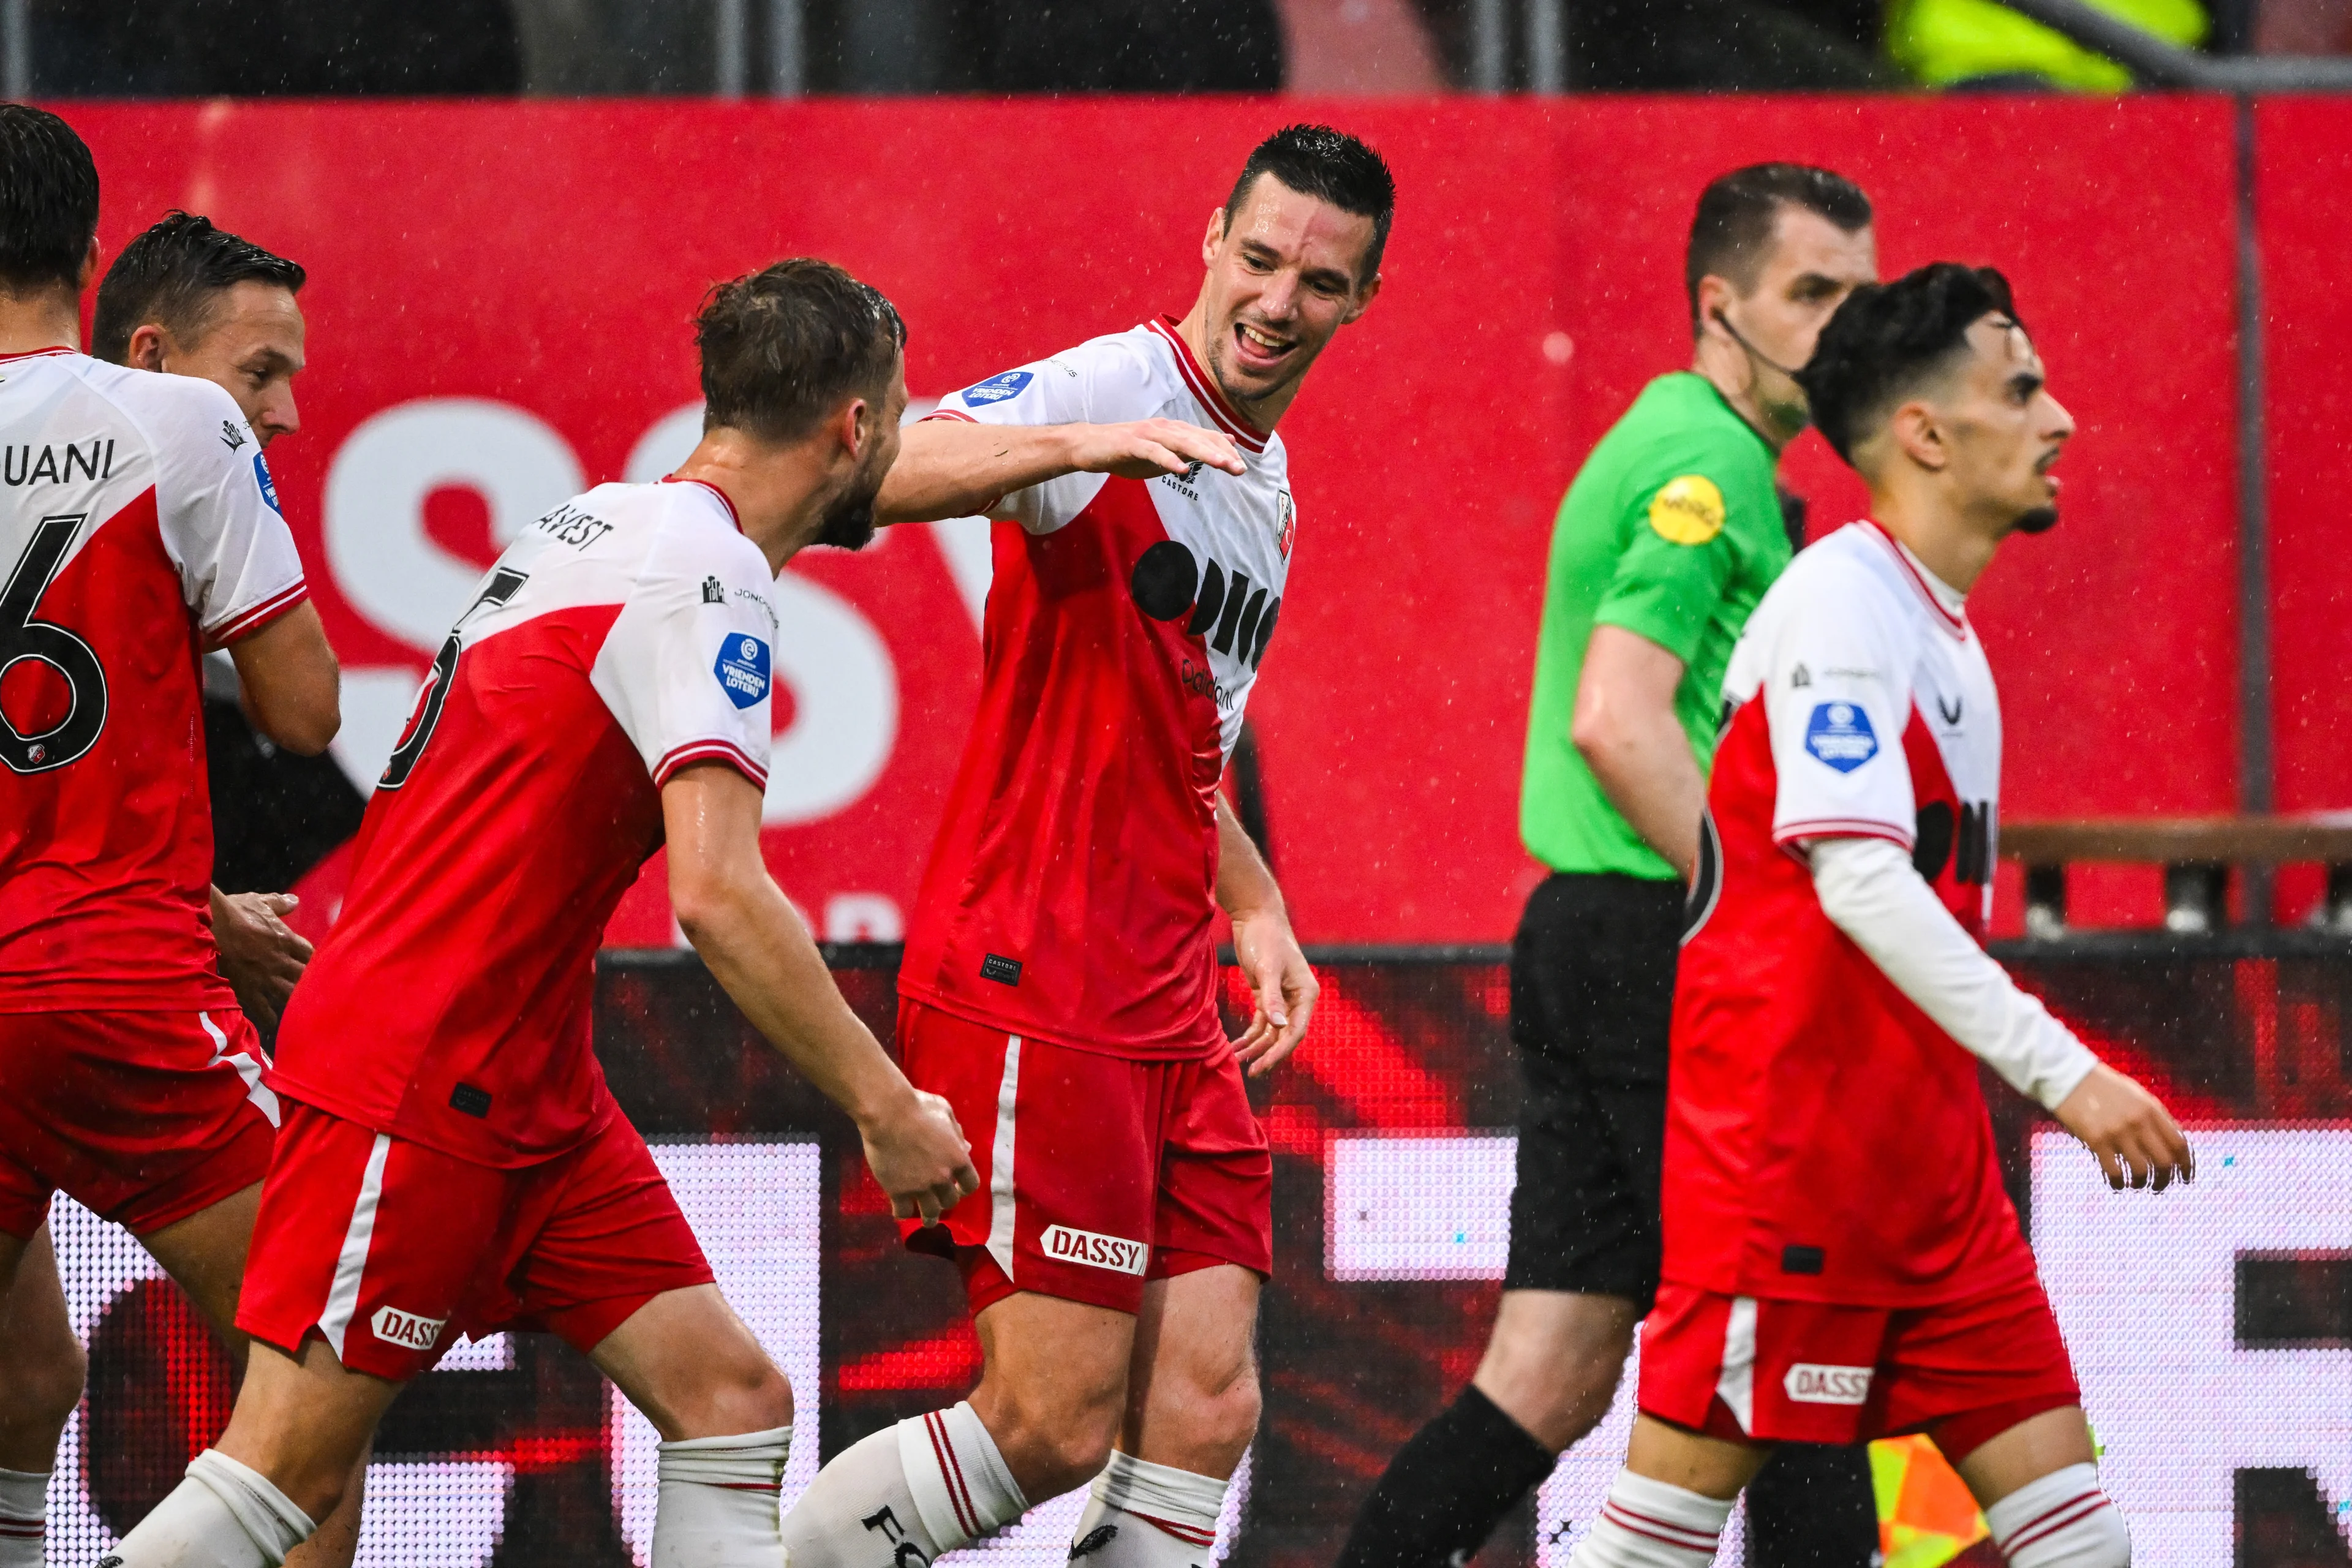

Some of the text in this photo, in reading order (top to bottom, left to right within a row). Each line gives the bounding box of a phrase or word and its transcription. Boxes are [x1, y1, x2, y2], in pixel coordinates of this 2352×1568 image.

[973, 387, 1014, 396] VRIENDEN
[0, 439, 115, 486] UANI
[1161, 475, 1199, 501] CASTORE
[0, 513, 109, 774] 6
[722, 663, 765, 690] VRIENDEN
[726, 676, 760, 698] LOTERIJ
[988, 959, 1016, 971] CASTORE
[1052, 1229, 1140, 1270] DASSY
[1797, 1370, 1872, 1397] DASS
